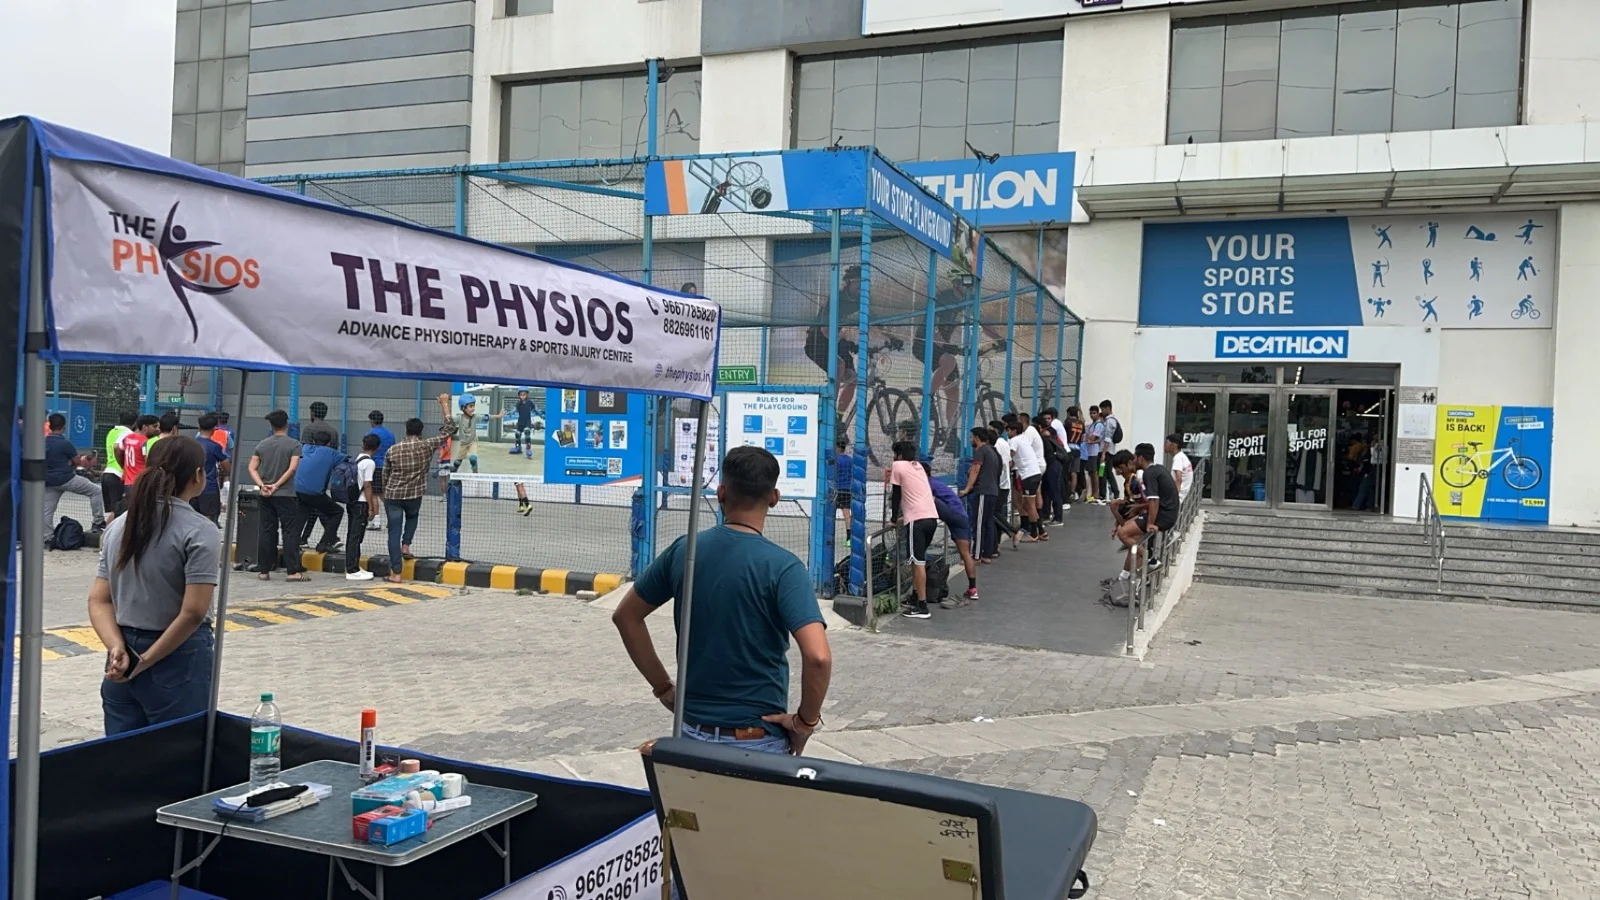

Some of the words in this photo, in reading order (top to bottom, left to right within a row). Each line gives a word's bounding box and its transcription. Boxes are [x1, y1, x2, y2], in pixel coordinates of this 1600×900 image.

[871, 167, 890, 211] YOUR
[891, 183, 913, 225] STORE
[913, 199, 951, 249] PLAYGROUND
[108, 211, 156, 240] THE
[1205, 233, 1296, 262] YOUR
[1203, 266, 1295, 287] SPORTS
[331, 252, 446, 321] THE
[460, 274, 634, 345] PHYSIOS
[1201, 291, 1295, 316] STORE
[662, 298, 716, 323] 9667785820
[663, 318, 714, 341] 8826961161
[338, 319, 411, 341] ADVANCE
[414, 328, 518, 351] PHYSIOTHERAPY
[520, 339, 527, 351] &
[530, 340, 569, 356] SPORTS
[570, 344, 601, 360] INJURY
[602, 349, 633, 363] CENTRE
[1222, 336, 1344, 354] DECATHLON
[665, 366, 711, 384] thephysios.in
[719, 369, 750, 380] ENTRY
[759, 403, 808, 411] PLAYGROUND
[1182, 432, 1203, 443] EXIT
[1288, 431, 1306, 442] ALL
[1307, 428, 1327, 439] FOR
[1446, 423, 1455, 432] IS
[1457, 424, 1486, 433] BACK!
[1228, 434, 1266, 450] SPORT
[1289, 438, 1327, 453] SPORT
[124, 445, 136, 468] 10
[1228, 449, 1246, 459] FOR
[1248, 446, 1266, 456] ALL
